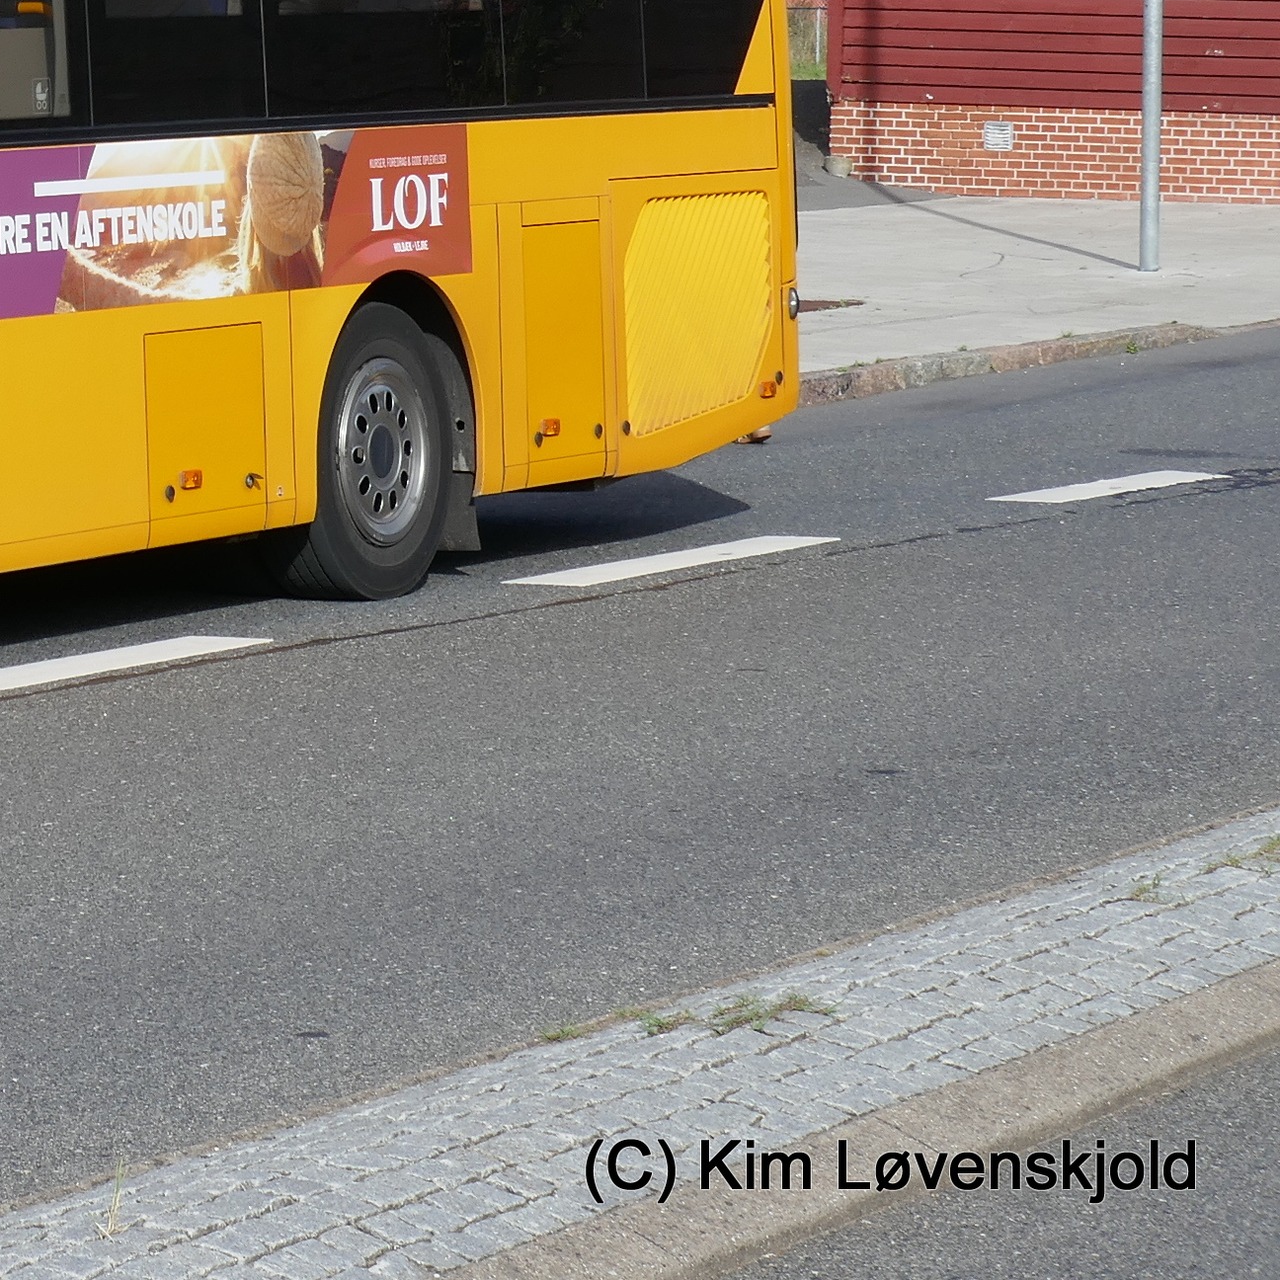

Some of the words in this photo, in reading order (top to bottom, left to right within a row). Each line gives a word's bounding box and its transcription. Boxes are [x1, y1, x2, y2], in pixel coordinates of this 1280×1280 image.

[35, 211, 69, 252] EN
[74, 200, 227, 249] AFTENSKOLE
[369, 172, 448, 232] LOF
